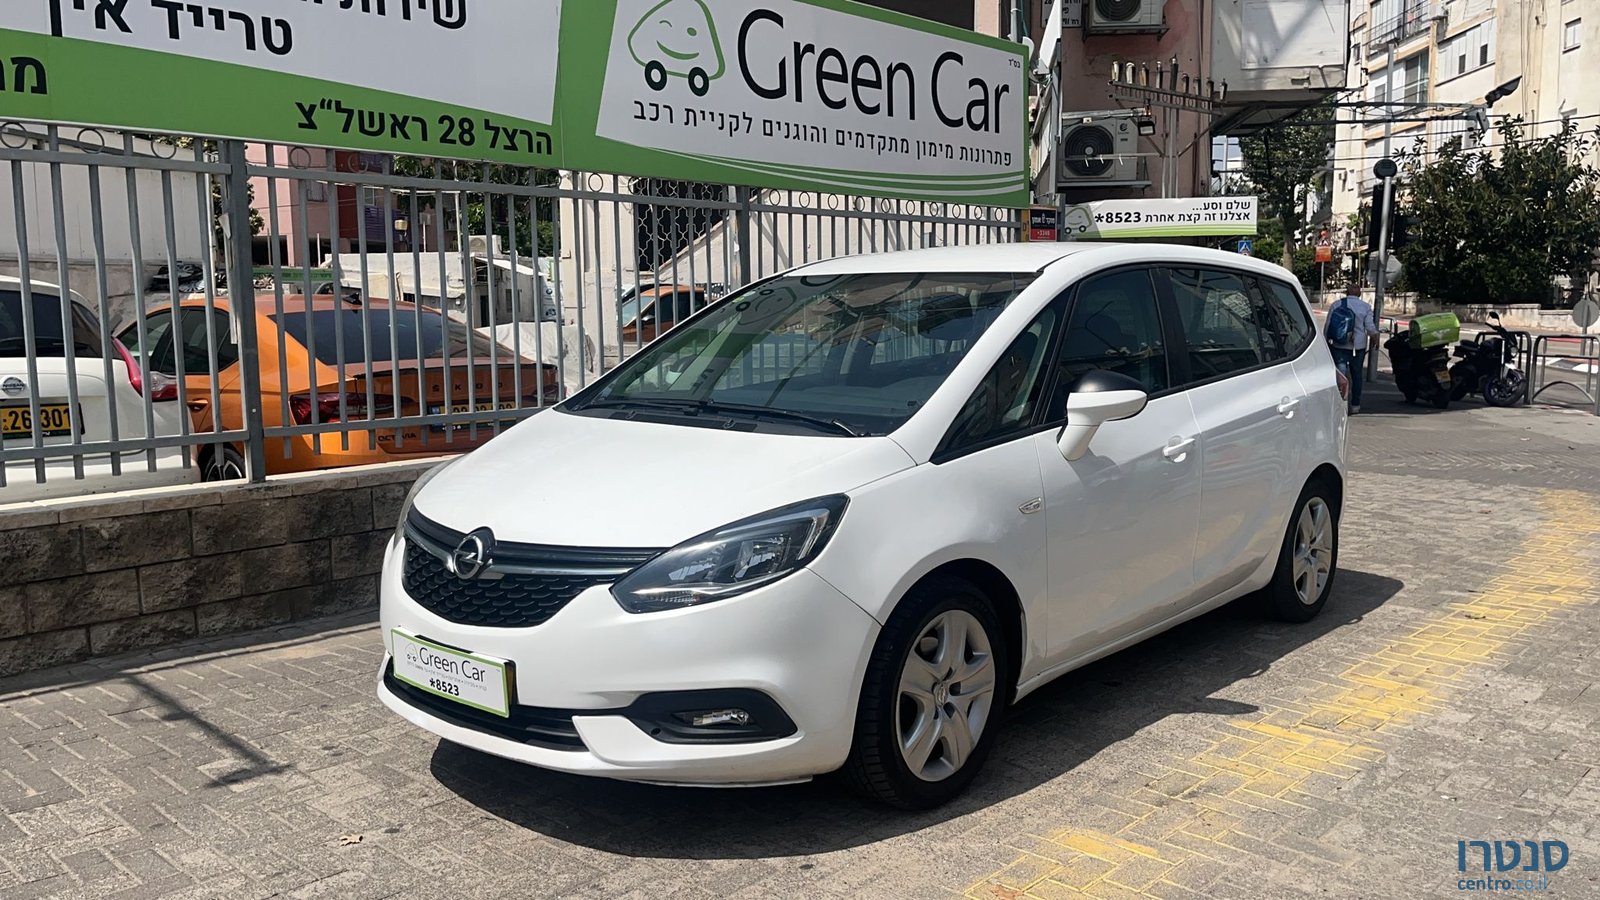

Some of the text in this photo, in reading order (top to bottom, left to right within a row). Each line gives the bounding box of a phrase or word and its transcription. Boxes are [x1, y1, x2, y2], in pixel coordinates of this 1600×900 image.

[150, 0, 292, 55] טרייד
[737, 9, 1010, 134] Green Car
[438, 115, 476, 147] 28
[484, 119, 553, 155] הרצל
[633, 100, 1012, 167] פתרונות מימון מתקדמים והוגנים לקניית רכב
[1219, 210, 1251, 221] אצלנו
[1226, 200, 1251, 210] שלם
[1144, 213, 1175, 223] אחרת
[1177, 213, 1201, 224] קצת
[1204, 212, 1217, 222] זה
[378, 432, 417, 441] OCTVIA
[420, 647, 459, 675] Green
[461, 660, 486, 683] Car
